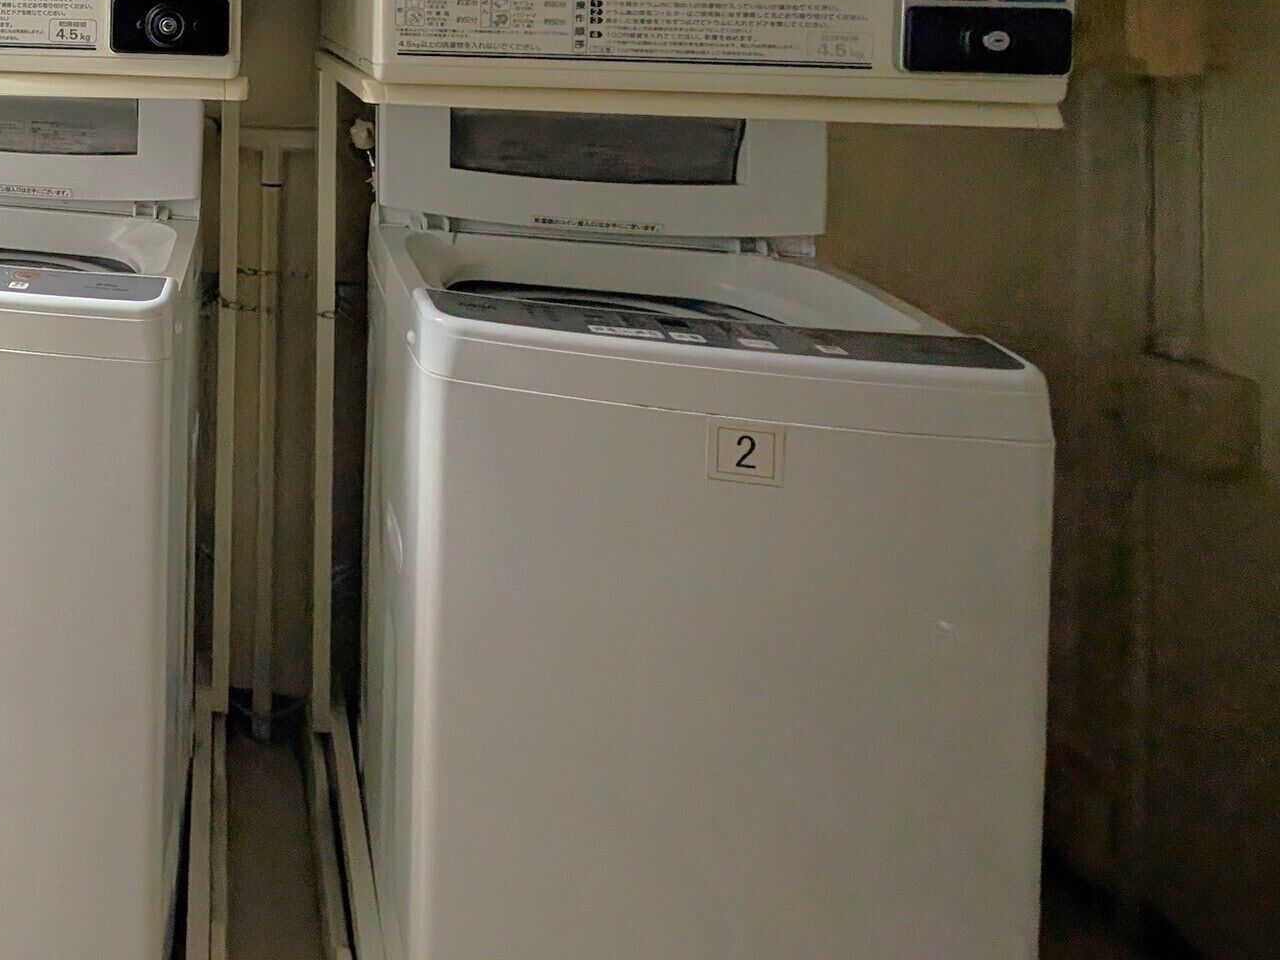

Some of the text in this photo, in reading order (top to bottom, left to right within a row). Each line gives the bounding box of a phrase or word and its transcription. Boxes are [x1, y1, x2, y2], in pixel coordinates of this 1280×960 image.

[56, 29, 78, 40] 4.5
[79, 32, 91, 42] kg
[736, 434, 757, 470] 2
